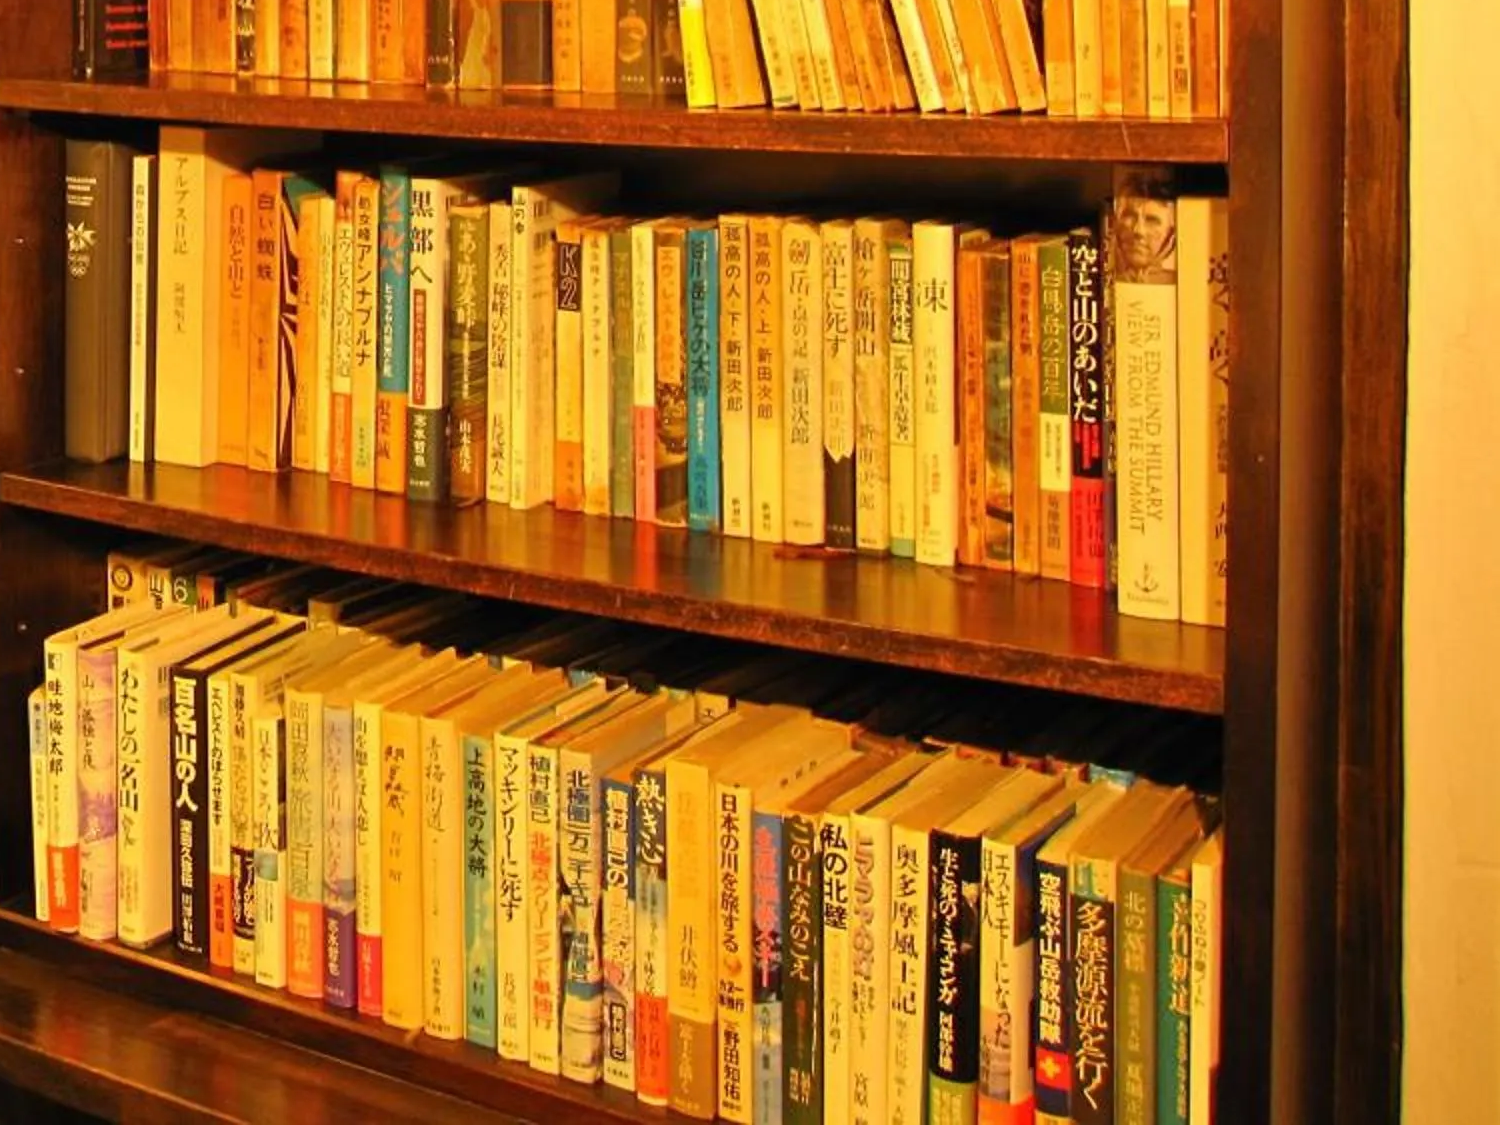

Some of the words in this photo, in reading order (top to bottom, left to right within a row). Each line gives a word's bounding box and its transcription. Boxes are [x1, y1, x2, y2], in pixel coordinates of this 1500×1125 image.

[256, 193, 276, 281] 白い蜘蛛
[410, 190, 433, 283] 黒部へ
[560, 243, 578, 310] K2
[824, 241, 849, 359] 富士に死す
[917, 278, 949, 314] 凍
[1071, 244, 1099, 423] 空と山のあいだ
[1126, 299, 1143, 349] VIEW
[1143, 314, 1162, 341] SIR
[1126, 353, 1145, 409] FROM
[1144, 350, 1163, 438] EDMUND
[1128, 413, 1145, 453] THE
[1128, 456, 1146, 536] SUMMIT
[1145, 441, 1164, 523] HILLARY
[48, 679, 66, 777] 畦地梅太郎
[173, 676, 198, 813] 百名山の人
[467, 746, 488, 879] 上高地の大将
[529, 755, 551, 824] 植村直己
[500, 747, 523, 923] マッキンリーに死す
[719, 793, 740, 954] 日本の川を旅する
[820, 823, 848, 931] 私の北壁
[891, 844, 920, 1016] 奥多摩風土記
[1075, 901, 1109, 1111] 多摩源流を行く
[723, 1027, 741, 1101] 野田知佑
